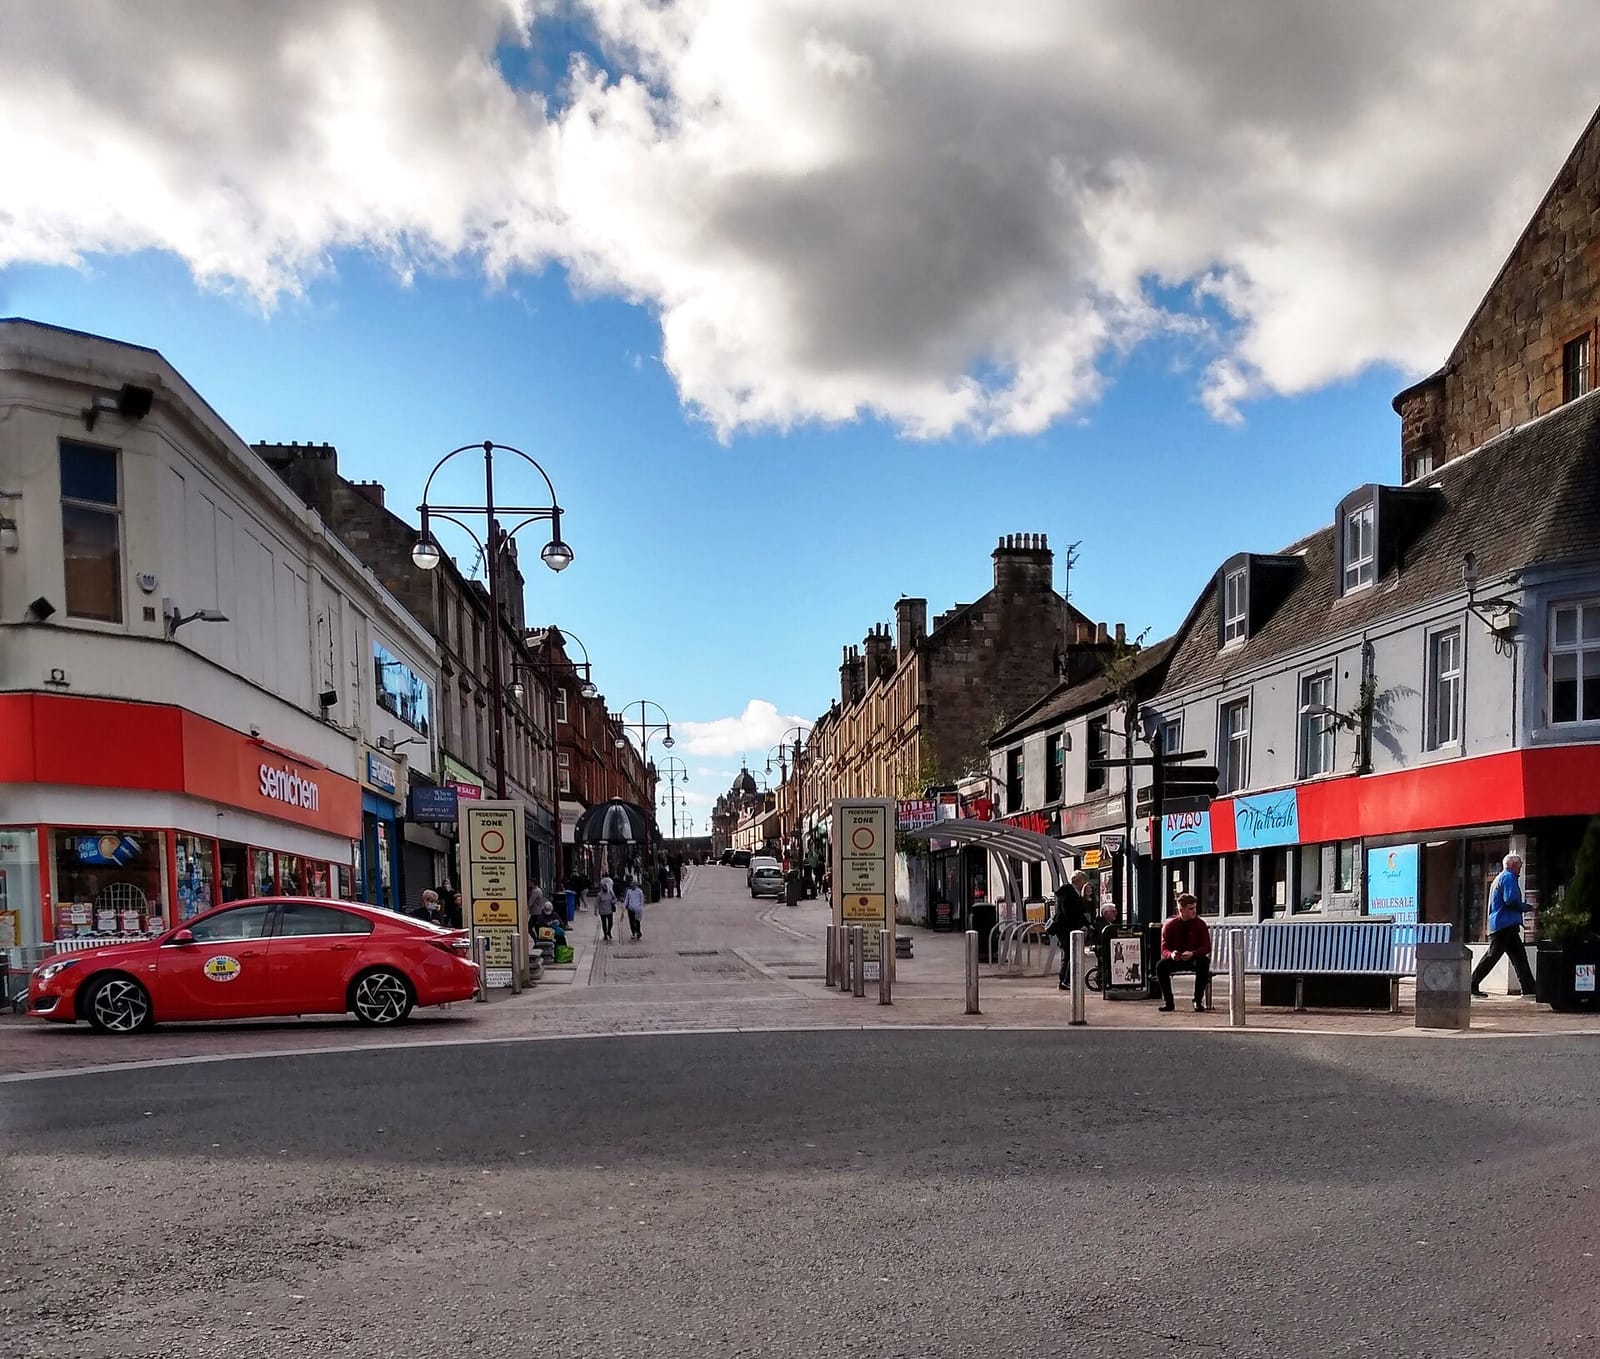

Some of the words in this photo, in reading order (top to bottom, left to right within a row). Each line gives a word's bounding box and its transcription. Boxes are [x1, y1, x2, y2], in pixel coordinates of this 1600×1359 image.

[259, 764, 319, 811] semichem
[900, 801, 912, 813] TO
[917, 800, 933, 810] LET
[480, 819, 503, 827] ZONE
[1371, 897, 1414, 909] WHOLESALE
